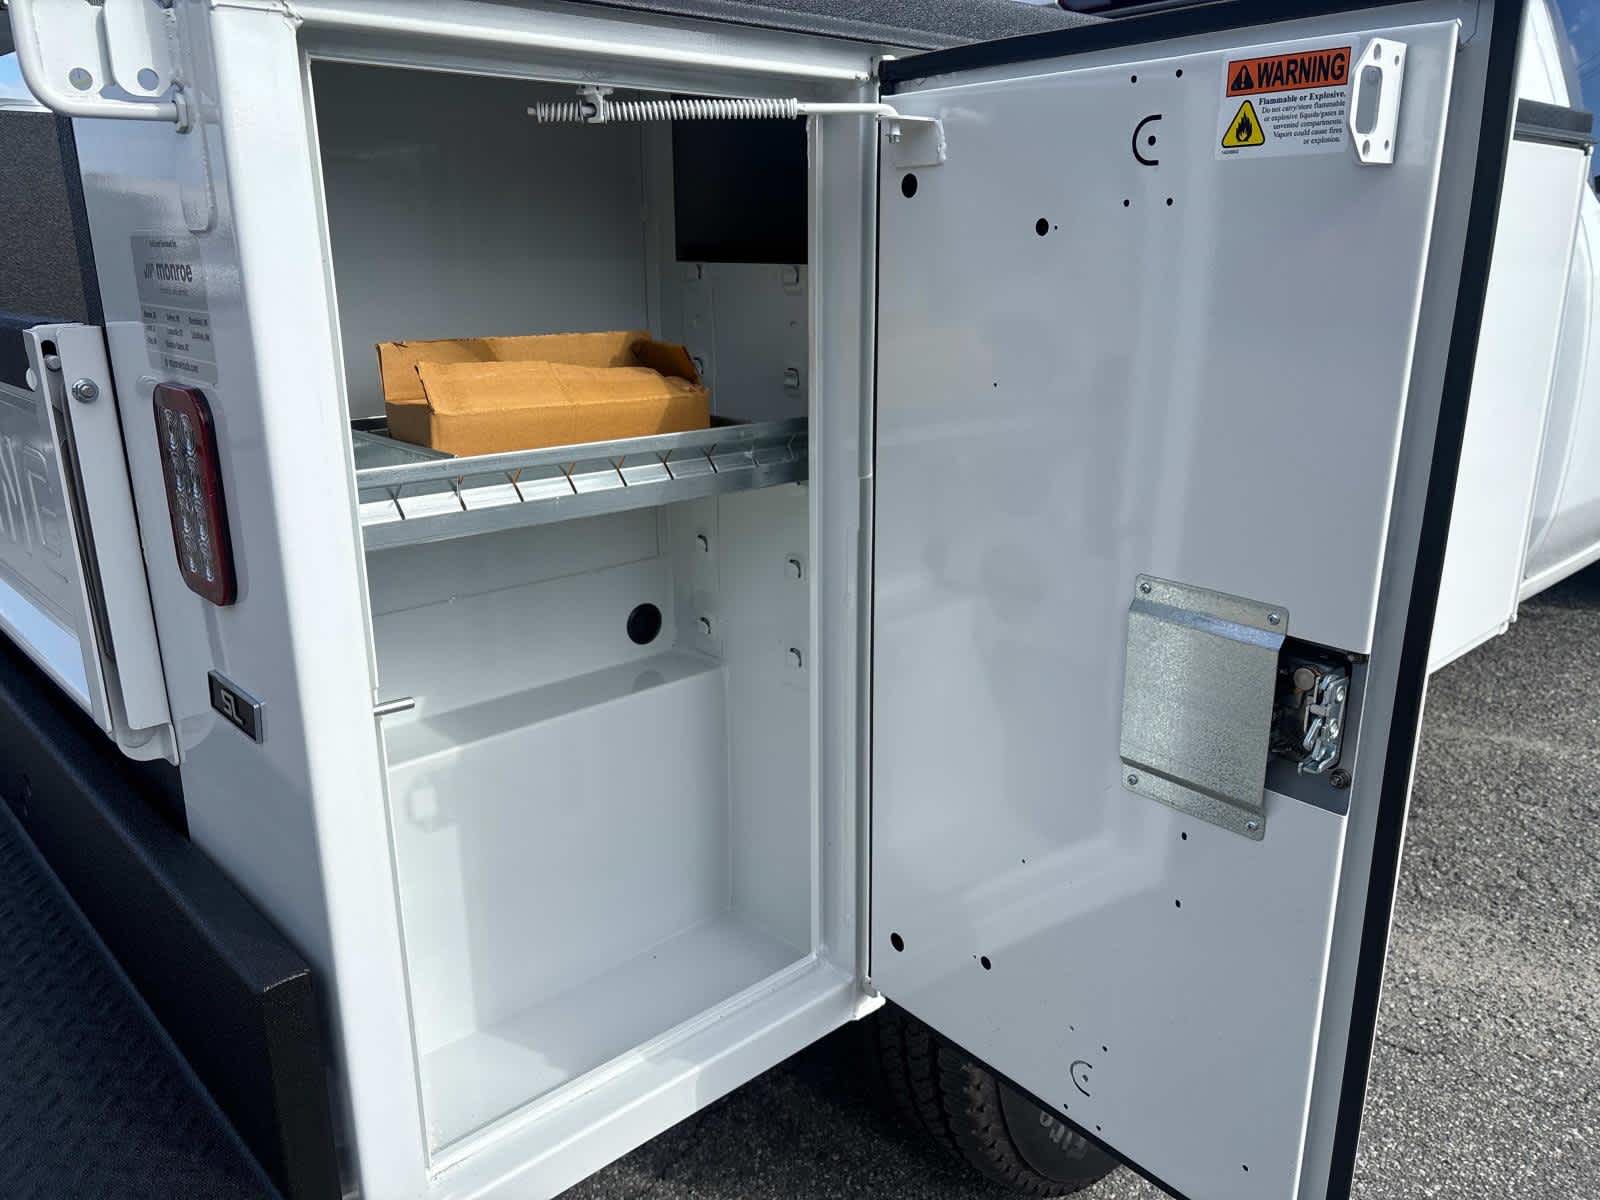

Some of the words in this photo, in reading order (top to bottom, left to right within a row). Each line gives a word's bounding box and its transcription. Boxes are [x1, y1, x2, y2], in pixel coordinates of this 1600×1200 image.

[1257, 53, 1345, 89] WARNING
[1258, 96, 1298, 106] Flammable
[1308, 90, 1346, 101] Explosive.
[1262, 106, 1271, 114] Do
[1271, 105, 1281, 113] not
[1281, 104, 1313, 114] carry/store
[1313, 100, 1345, 109] flammable
[1271, 112, 1298, 123] explosive
[1293, 129, 1310, 137] could
[1311, 128, 1328, 136] cause
[156, 262, 193, 283] monroe
[220, 688, 244, 727] SL
